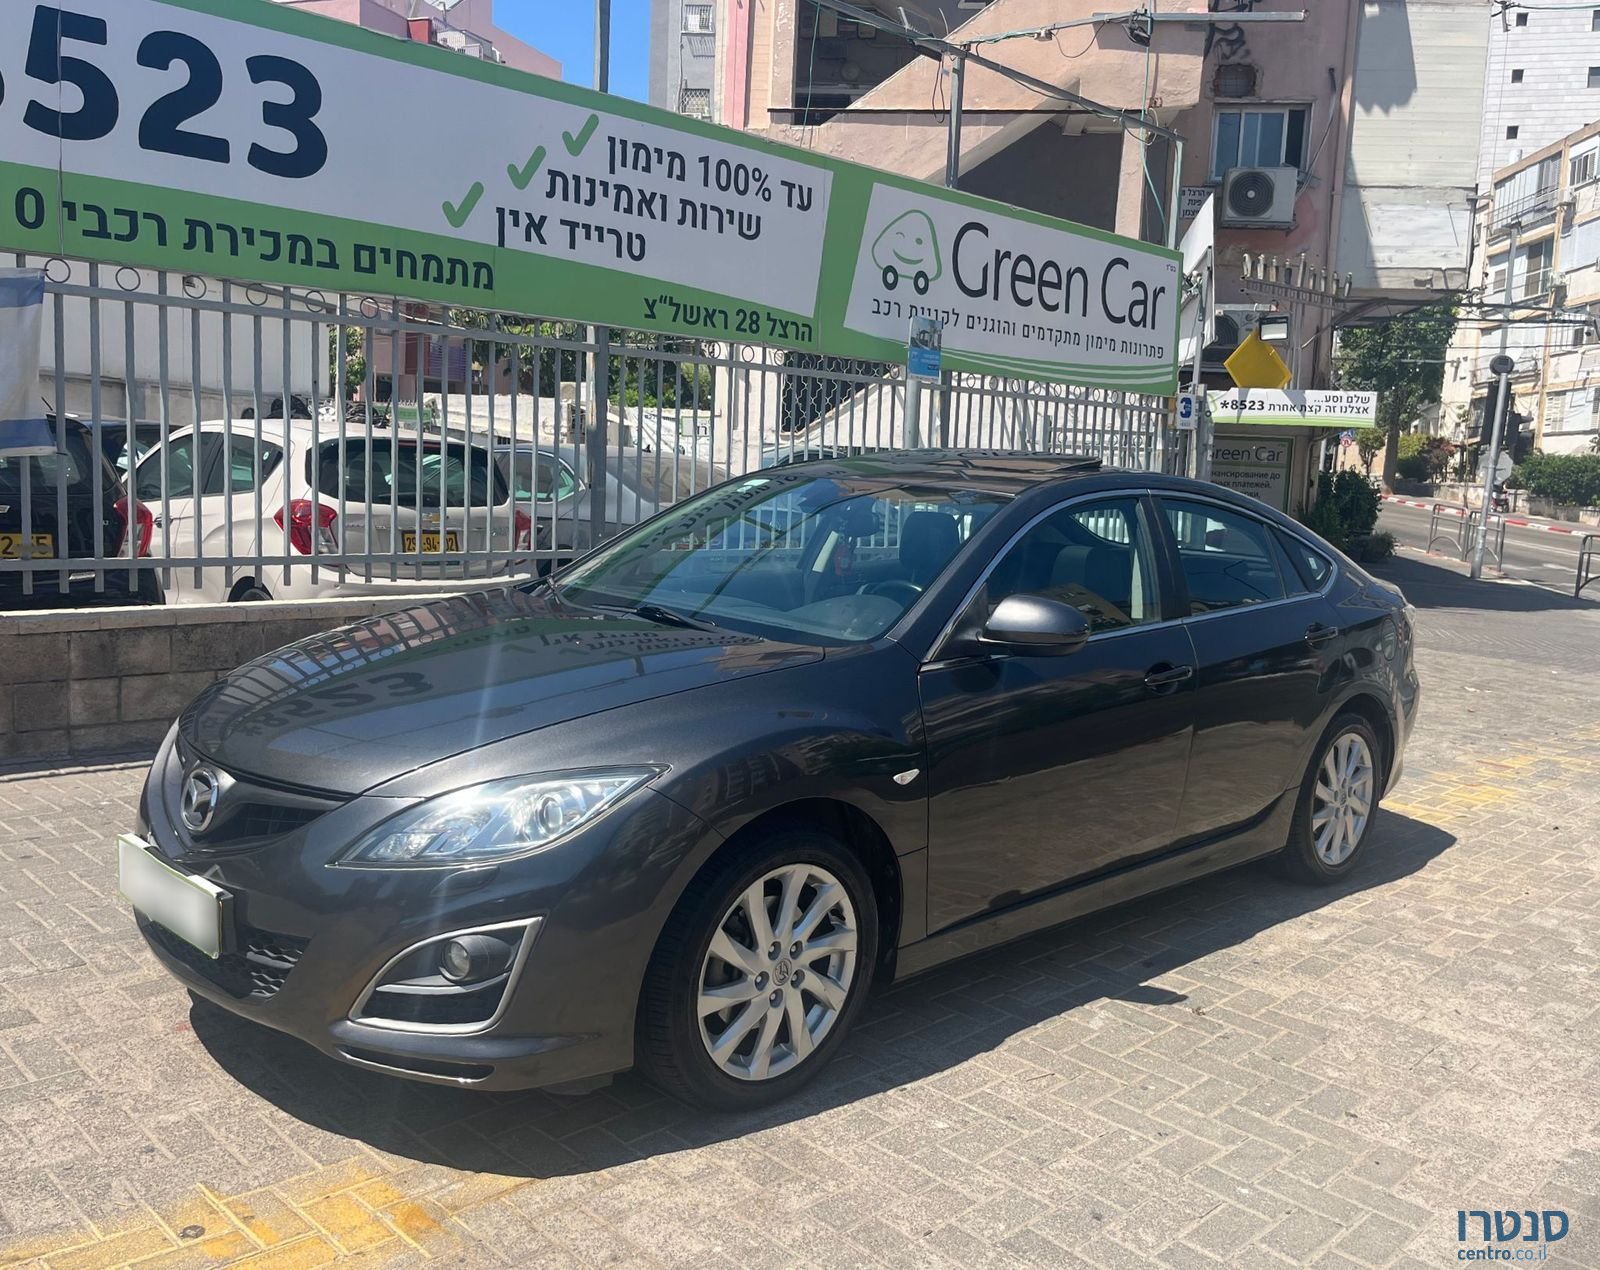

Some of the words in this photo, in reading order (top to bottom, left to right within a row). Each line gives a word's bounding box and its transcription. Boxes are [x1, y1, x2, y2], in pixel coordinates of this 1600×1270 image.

[0, 4, 329, 180] 523
[606, 135, 687, 182] מימון
[545, 168, 668, 222] ואמינות
[697, 154, 772, 203] 100%
[781, 178, 813, 212] עד
[61, 200, 168, 247] רכבי
[495, 205, 549, 248] אין
[677, 197, 761, 241] שירות
[182, 217, 340, 271] במכירת
[560, 218, 647, 262] טרייד
[353, 242, 495, 291] מתמחים
[952, 221, 1090, 318] Green
[1101, 257, 1166, 331] Car
[734, 308, 761, 334] 28
[871, 298, 901, 318] רכב
[766, 311, 813, 344] הרצל
[966, 314, 1016, 336] והוגנים
[1022, 323, 1081, 347] מתקדמים
[1085, 334, 1117, 351] מימון
[1120, 340, 1164, 359] פתרונות
[1267, 403, 1297, 413] אחרת
[1299, 404, 1322, 415] קצת
[1324, 404, 1337, 414] זה
[1339, 403, 1370, 415] אצלנו
[1345, 393, 1370, 405] שלם
[1255, 446, 1284, 462] Car
